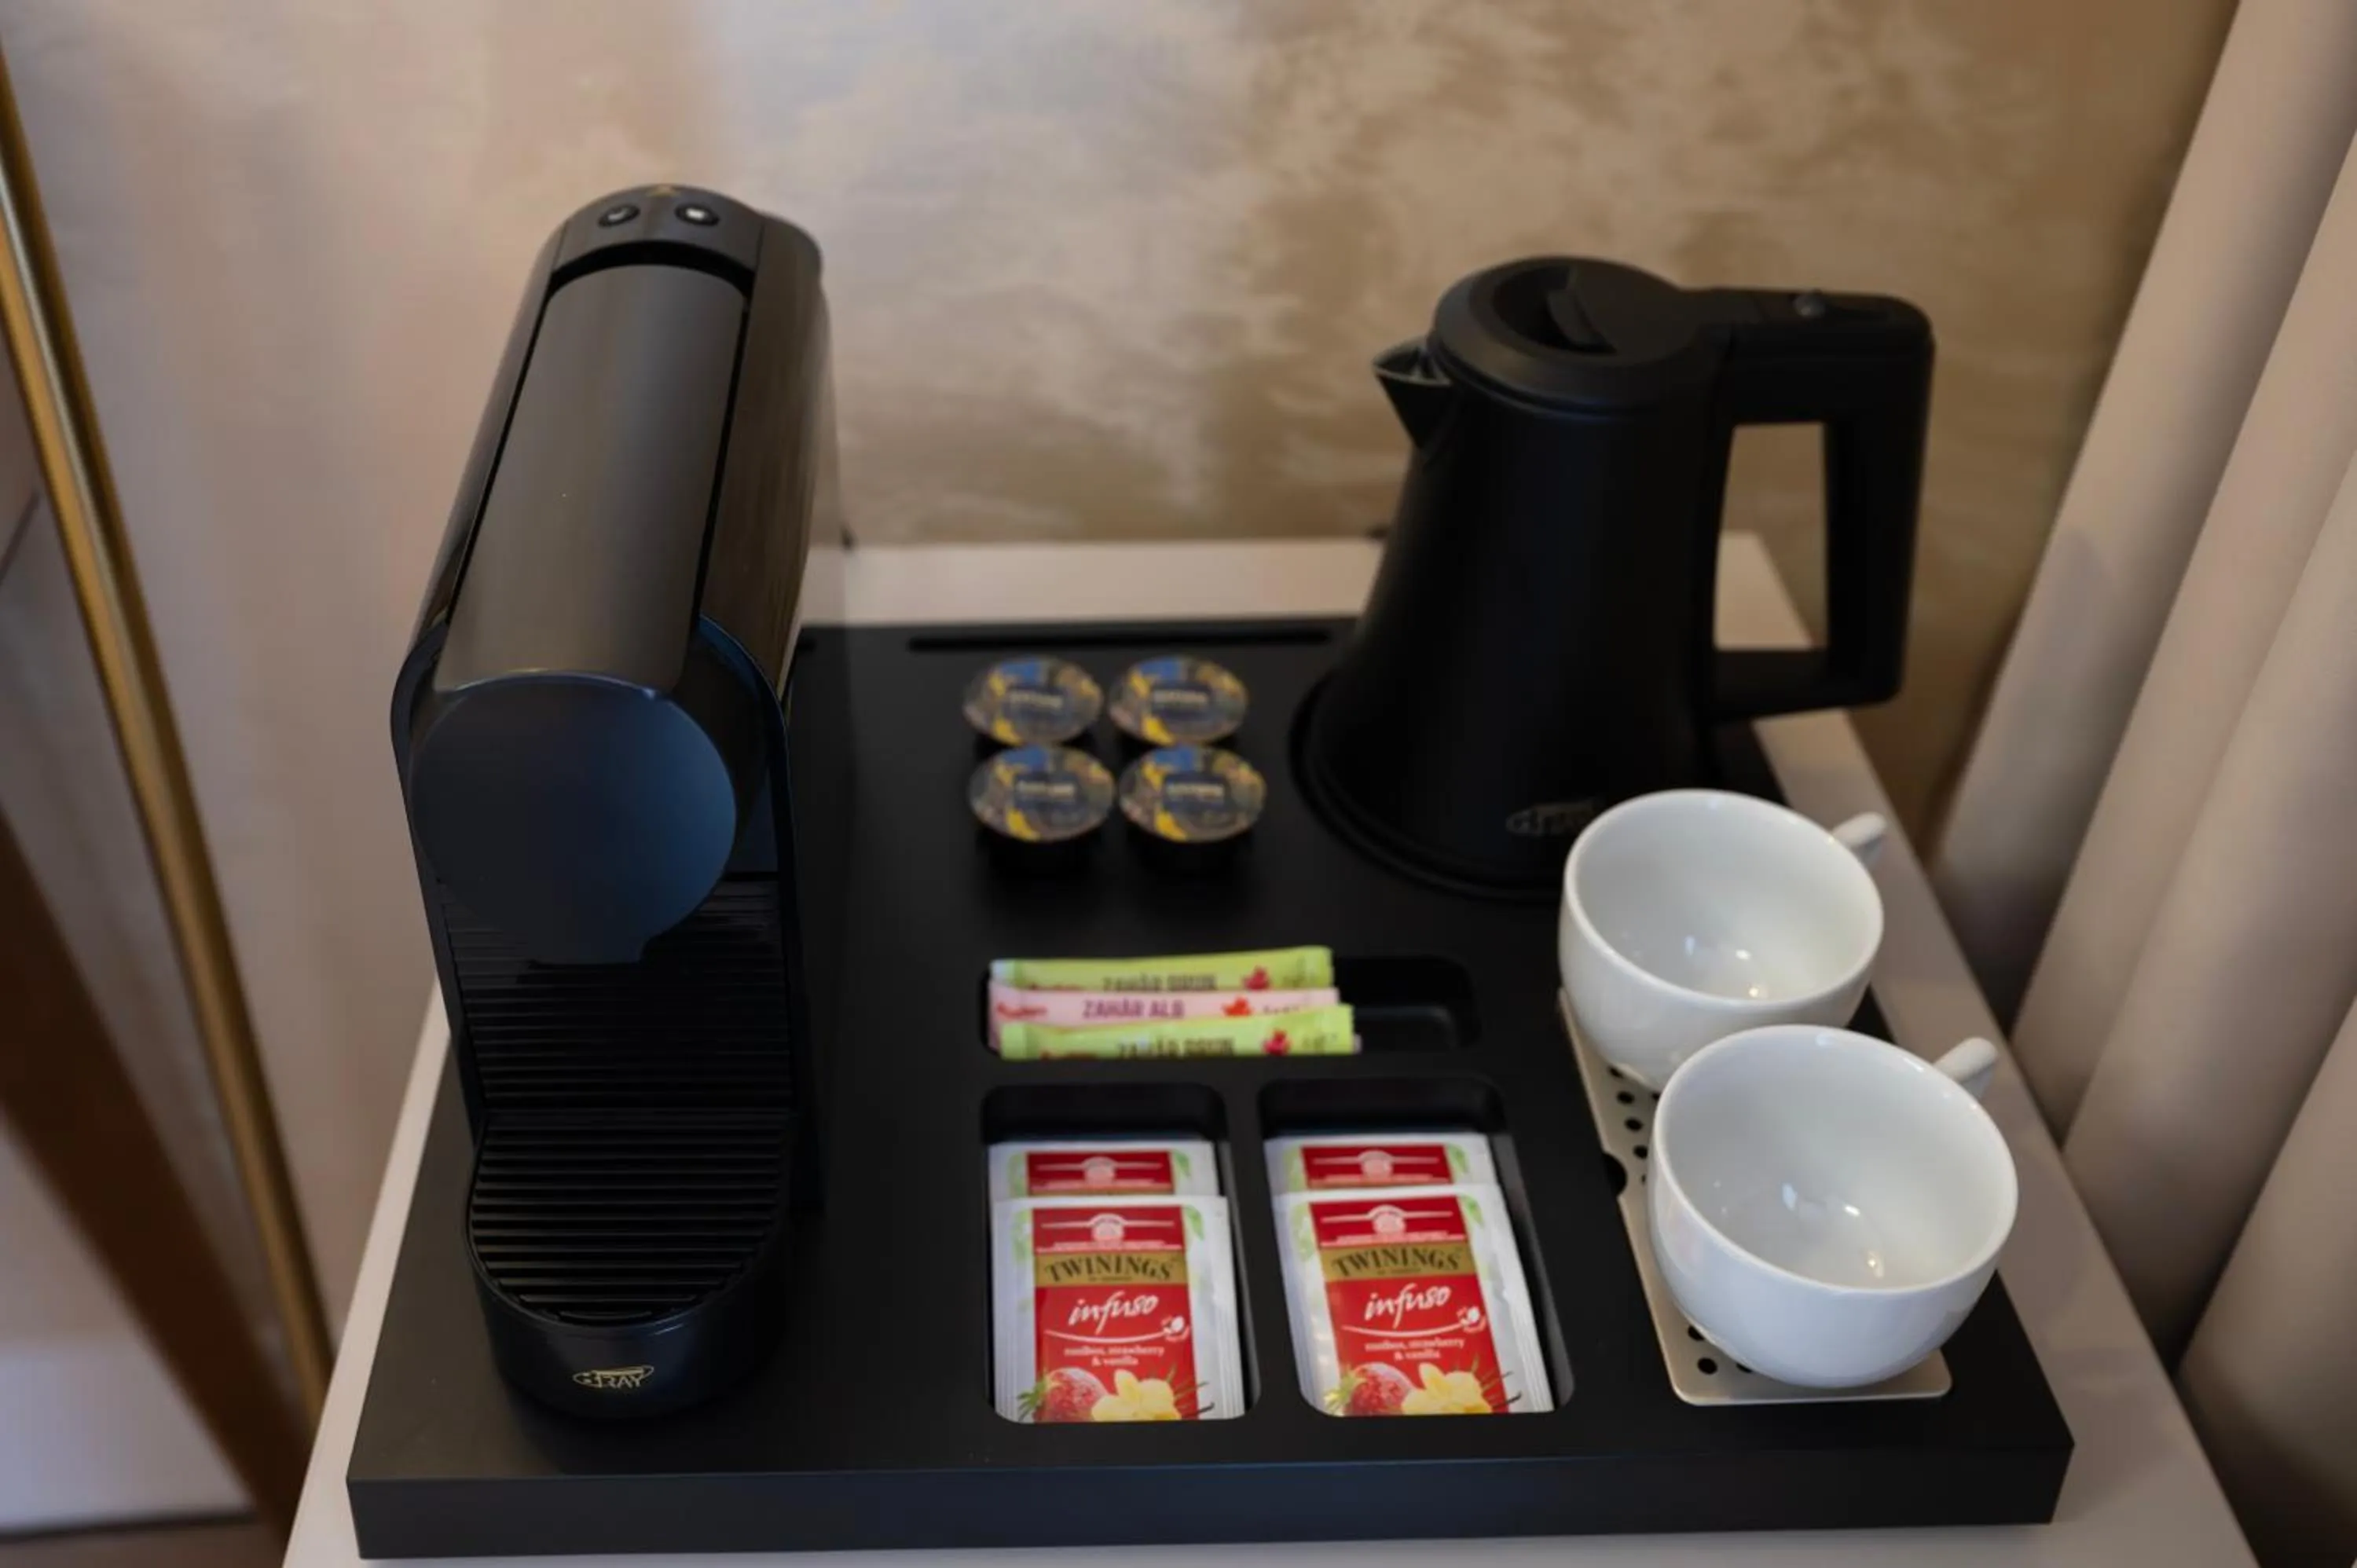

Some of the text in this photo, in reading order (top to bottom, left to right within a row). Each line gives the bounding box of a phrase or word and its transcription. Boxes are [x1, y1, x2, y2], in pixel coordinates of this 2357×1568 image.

[1044, 1255, 1173, 1282] TWININGS
[1330, 1245, 1460, 1277] TWININGS
[1068, 1290, 1159, 1335] infuso
[1365, 1282, 1450, 1330] infuso
